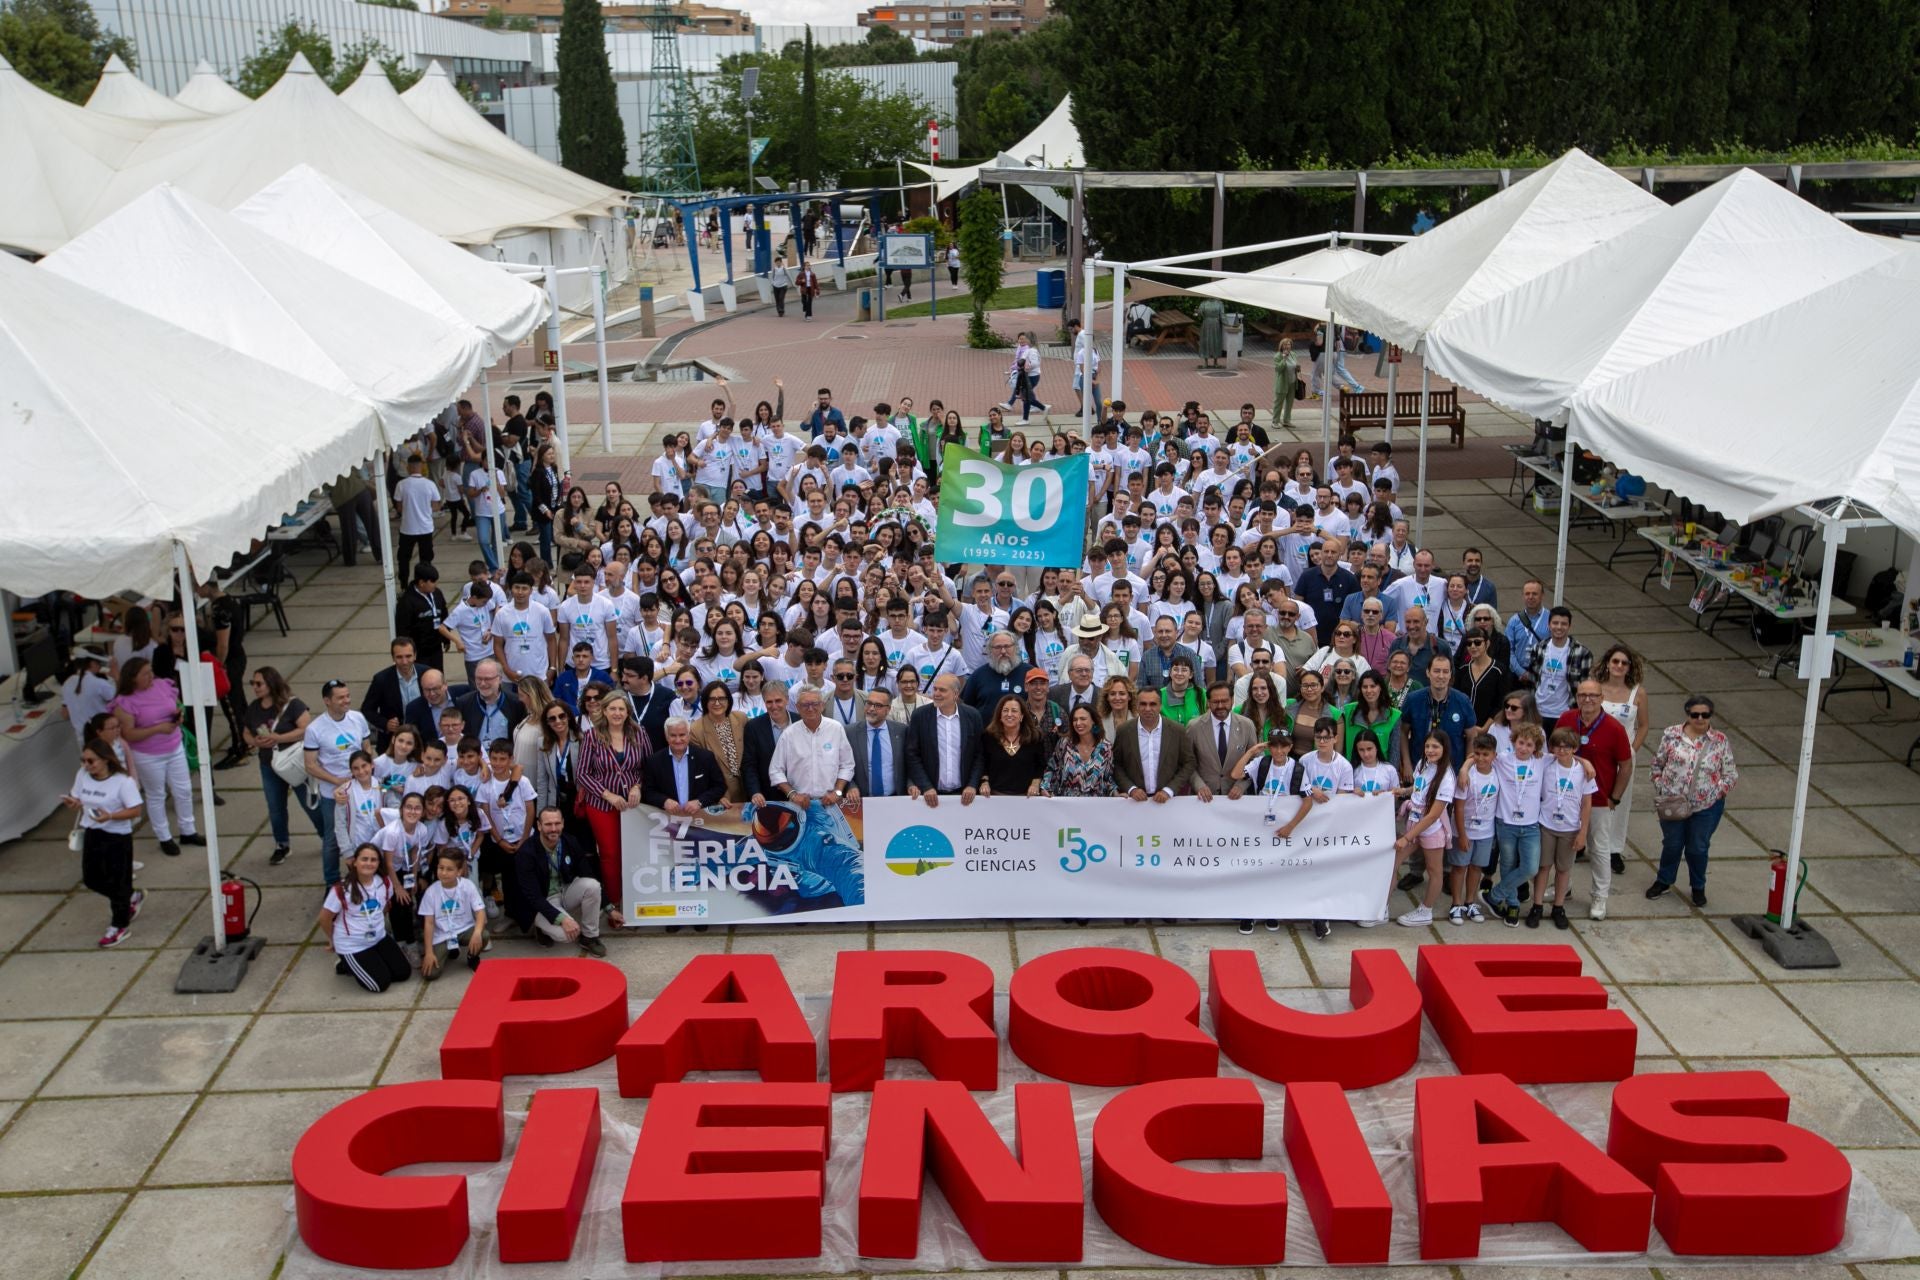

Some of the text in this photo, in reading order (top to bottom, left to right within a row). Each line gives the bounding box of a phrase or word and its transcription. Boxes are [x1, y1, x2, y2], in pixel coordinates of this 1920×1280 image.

[952, 459, 1064, 532] 30
[980, 533, 1029, 546] AÑOS
[963, 549, 997, 558] (1995
[1012, 549, 1046, 560] 2025)
[964, 828, 1031, 842] PARQUE
[1136, 835, 1371, 848] 15 MILLONES DE VISITAS
[650, 838, 768, 865] FERIA
[965, 845, 998, 855] de las
[965, 859, 1036, 872] CIENCIAS
[1135, 854, 1161, 867] 30
[1173, 855, 1220, 867] AÑOS
[1230, 858, 1263, 867] (1995
[1280, 858, 1313, 867] 2025)
[631, 864, 799, 894] CIENCIA
[441, 946, 1637, 1096] PARQUE
[292, 1073, 1851, 1267] CIENCIAS
